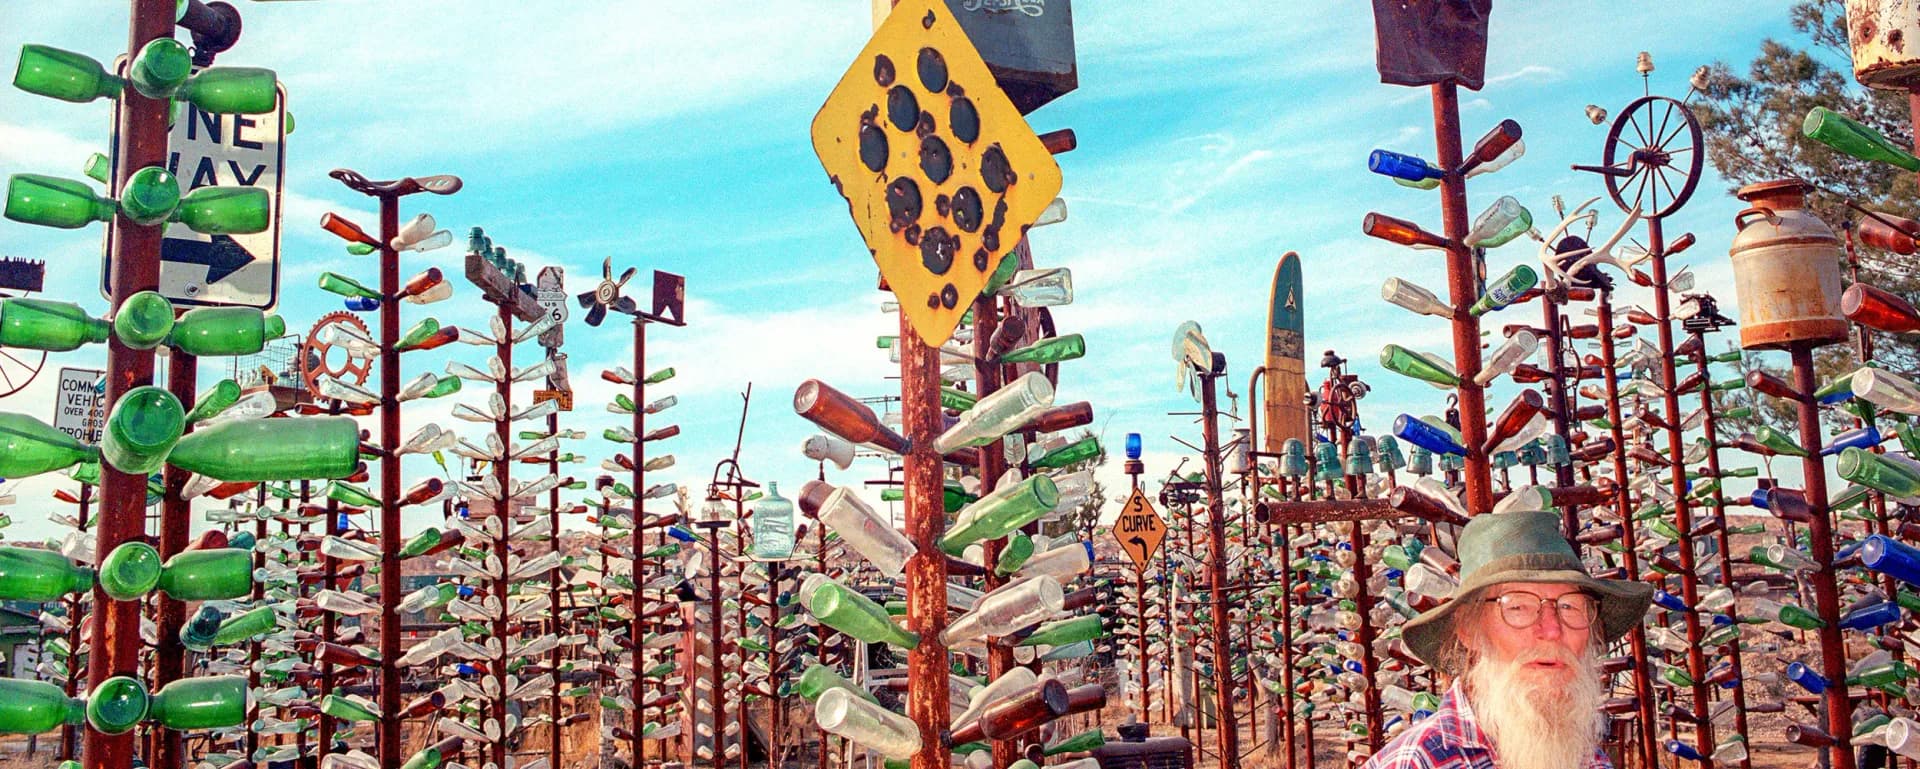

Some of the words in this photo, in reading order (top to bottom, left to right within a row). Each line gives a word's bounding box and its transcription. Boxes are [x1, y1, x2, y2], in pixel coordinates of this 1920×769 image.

[168, 101, 263, 150] NE
[168, 152, 267, 190] AY
[552, 308, 562, 321] 6
[62, 379, 96, 393] COMM
[67, 393, 104, 408] VEHIC
[64, 407, 84, 416] OVER
[88, 409, 104, 418] 400
[82, 418, 103, 428] GROS
[1133, 495, 1143, 512] S
[1122, 514, 1156, 532] CURVE
